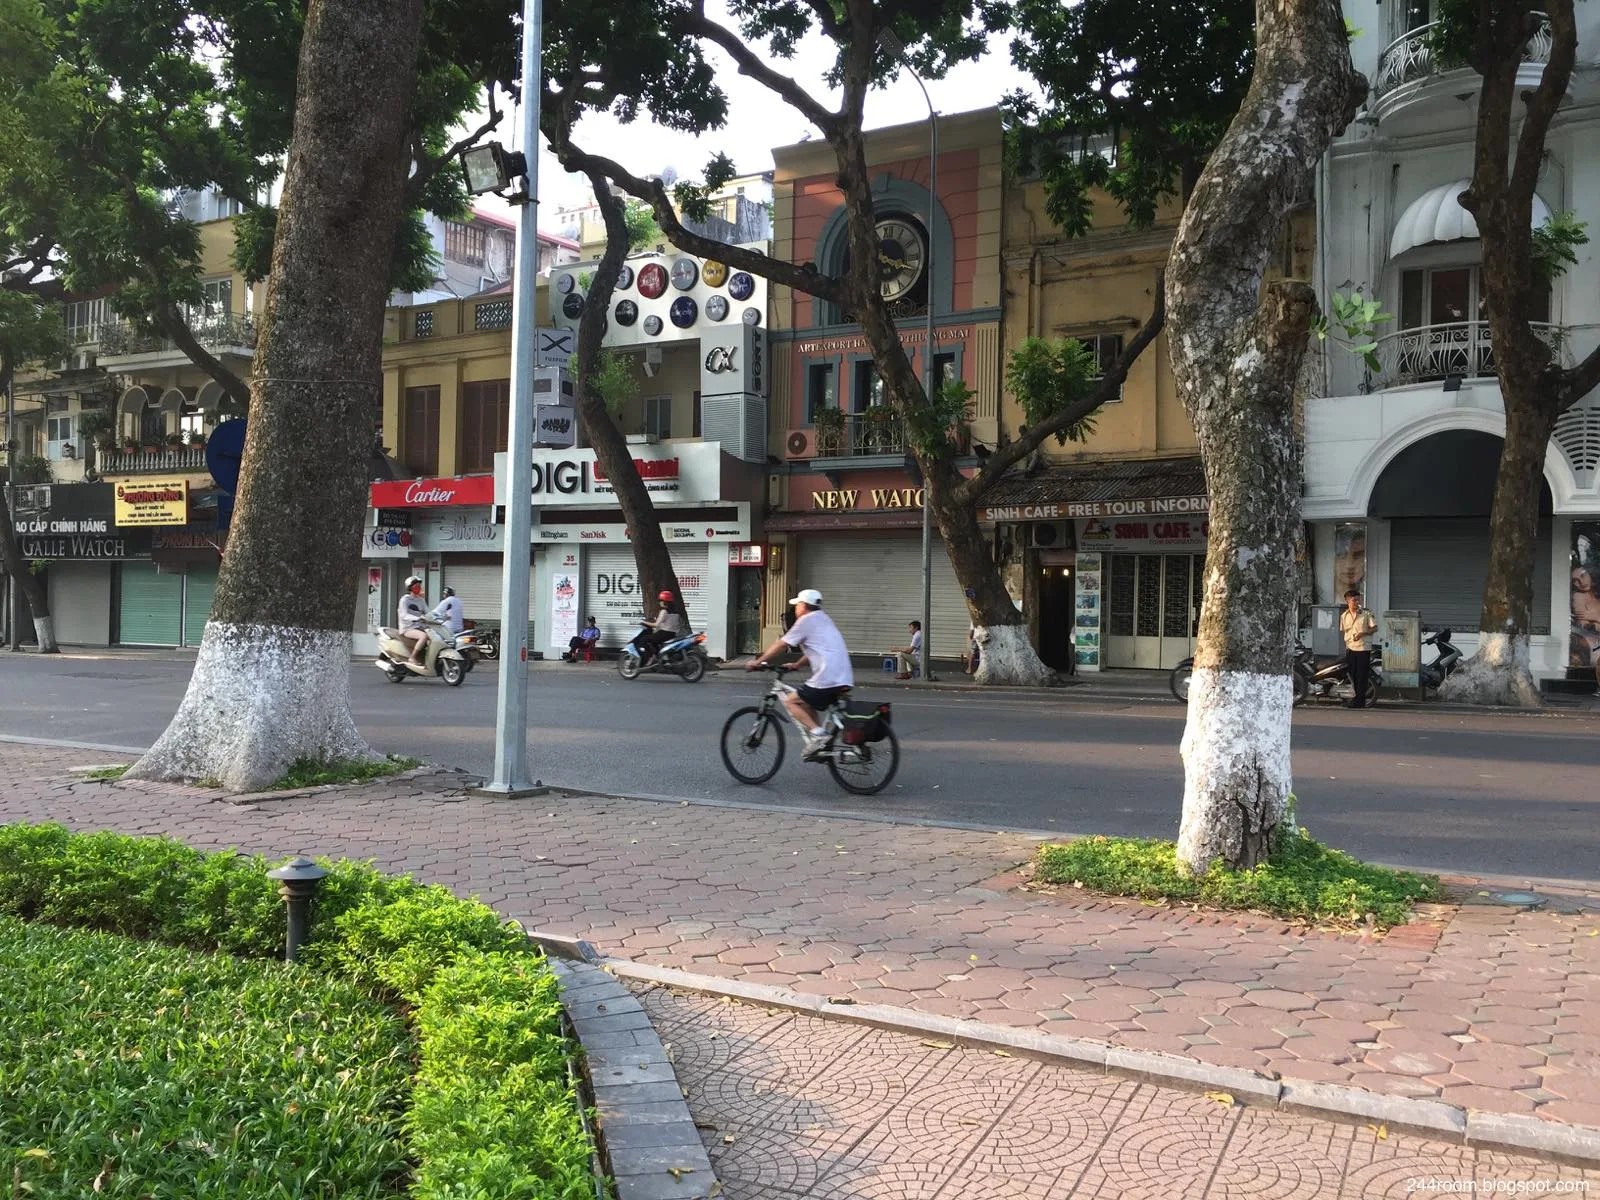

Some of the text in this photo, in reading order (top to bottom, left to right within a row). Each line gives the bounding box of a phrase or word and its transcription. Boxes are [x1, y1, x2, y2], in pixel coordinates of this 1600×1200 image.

[405, 482, 455, 503] Cartier
[812, 488, 925, 509] NEW WATC
[985, 506, 1020, 520] SINH
[1068, 503, 1100, 517] FREE
[1104, 500, 1146, 515] TOUR
[16, 521, 27, 533] AO
[50, 517, 77, 533] CHÍNH
[1153, 522, 1190, 538] CAFE
[580, 530, 607, 539] SanDisk
